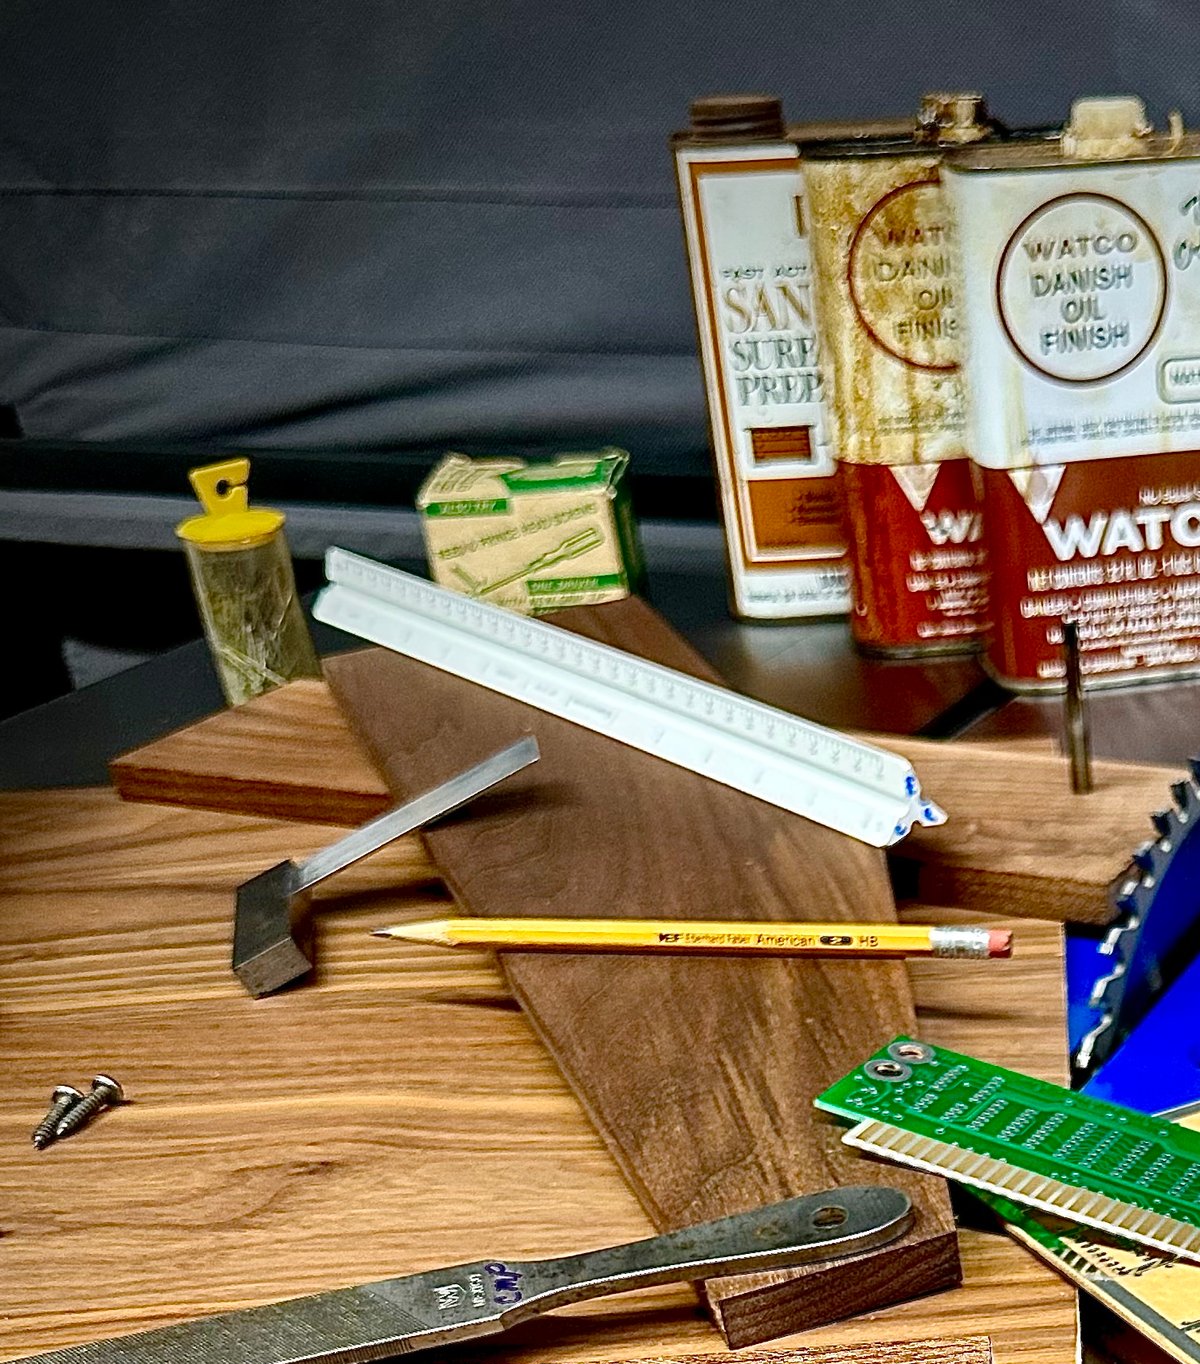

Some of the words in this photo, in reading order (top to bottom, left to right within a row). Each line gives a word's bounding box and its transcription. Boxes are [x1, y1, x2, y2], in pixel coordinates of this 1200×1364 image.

[1024, 231, 1138, 262] WATCO
[1030, 263, 1133, 298] DANISH
[1060, 299, 1106, 323] OIL
[1040, 323, 1130, 355] FINISH
[755, 933, 816, 946] American
[859, 935, 878, 947] HB
